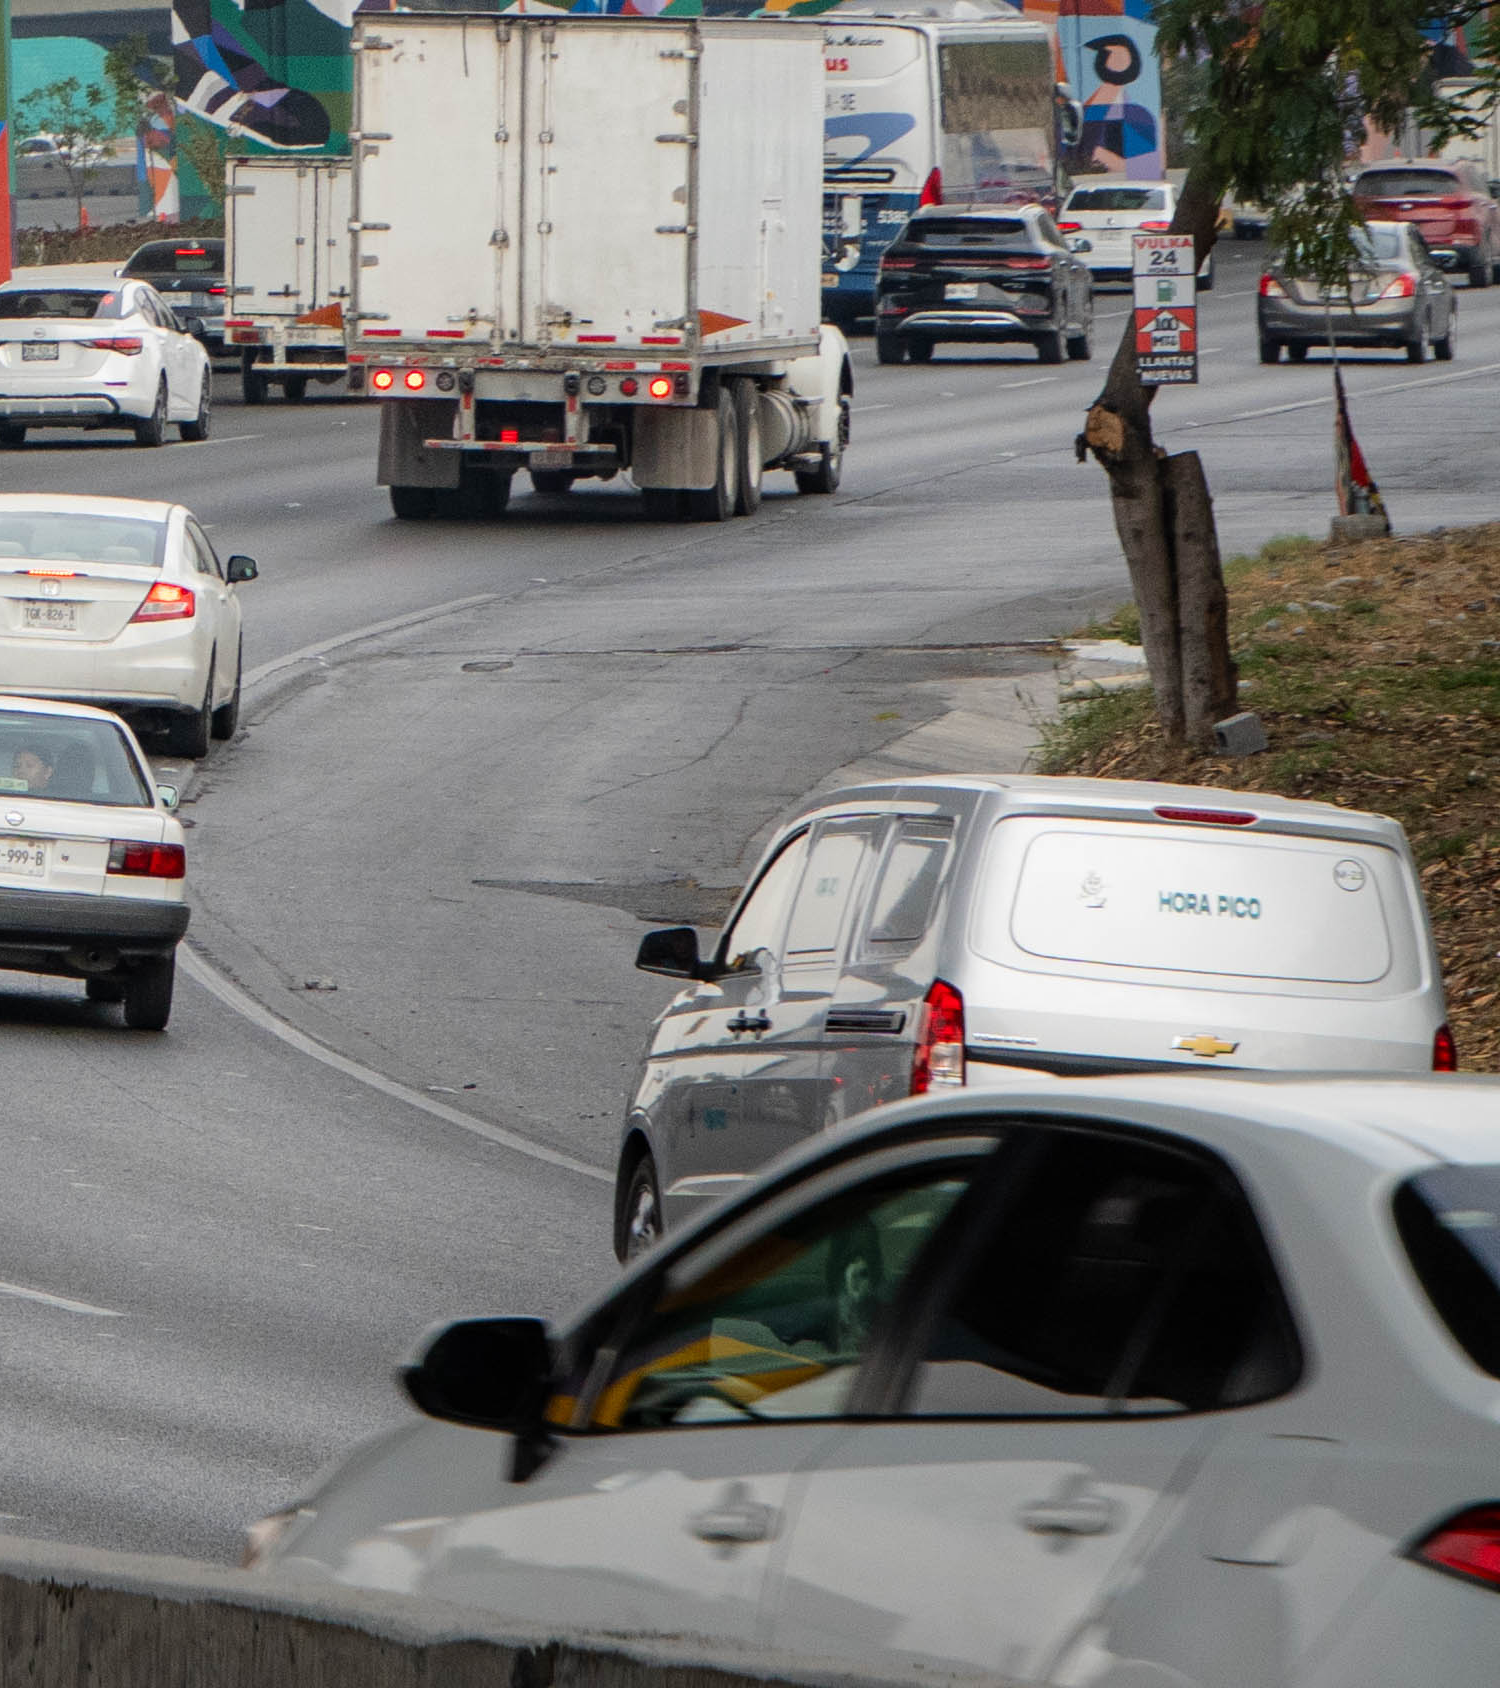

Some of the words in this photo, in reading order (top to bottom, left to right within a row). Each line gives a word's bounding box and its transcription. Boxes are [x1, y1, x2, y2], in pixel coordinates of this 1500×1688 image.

[1134, 237, 1194, 249] VULKA
[1150, 250, 1177, 265] 24
[1155, 317, 1179, 331] 100
[1138, 356, 1195, 367] LLANTAS
[1159, 891, 1212, 916] HORA
[1217, 895, 1261, 920] PICO
